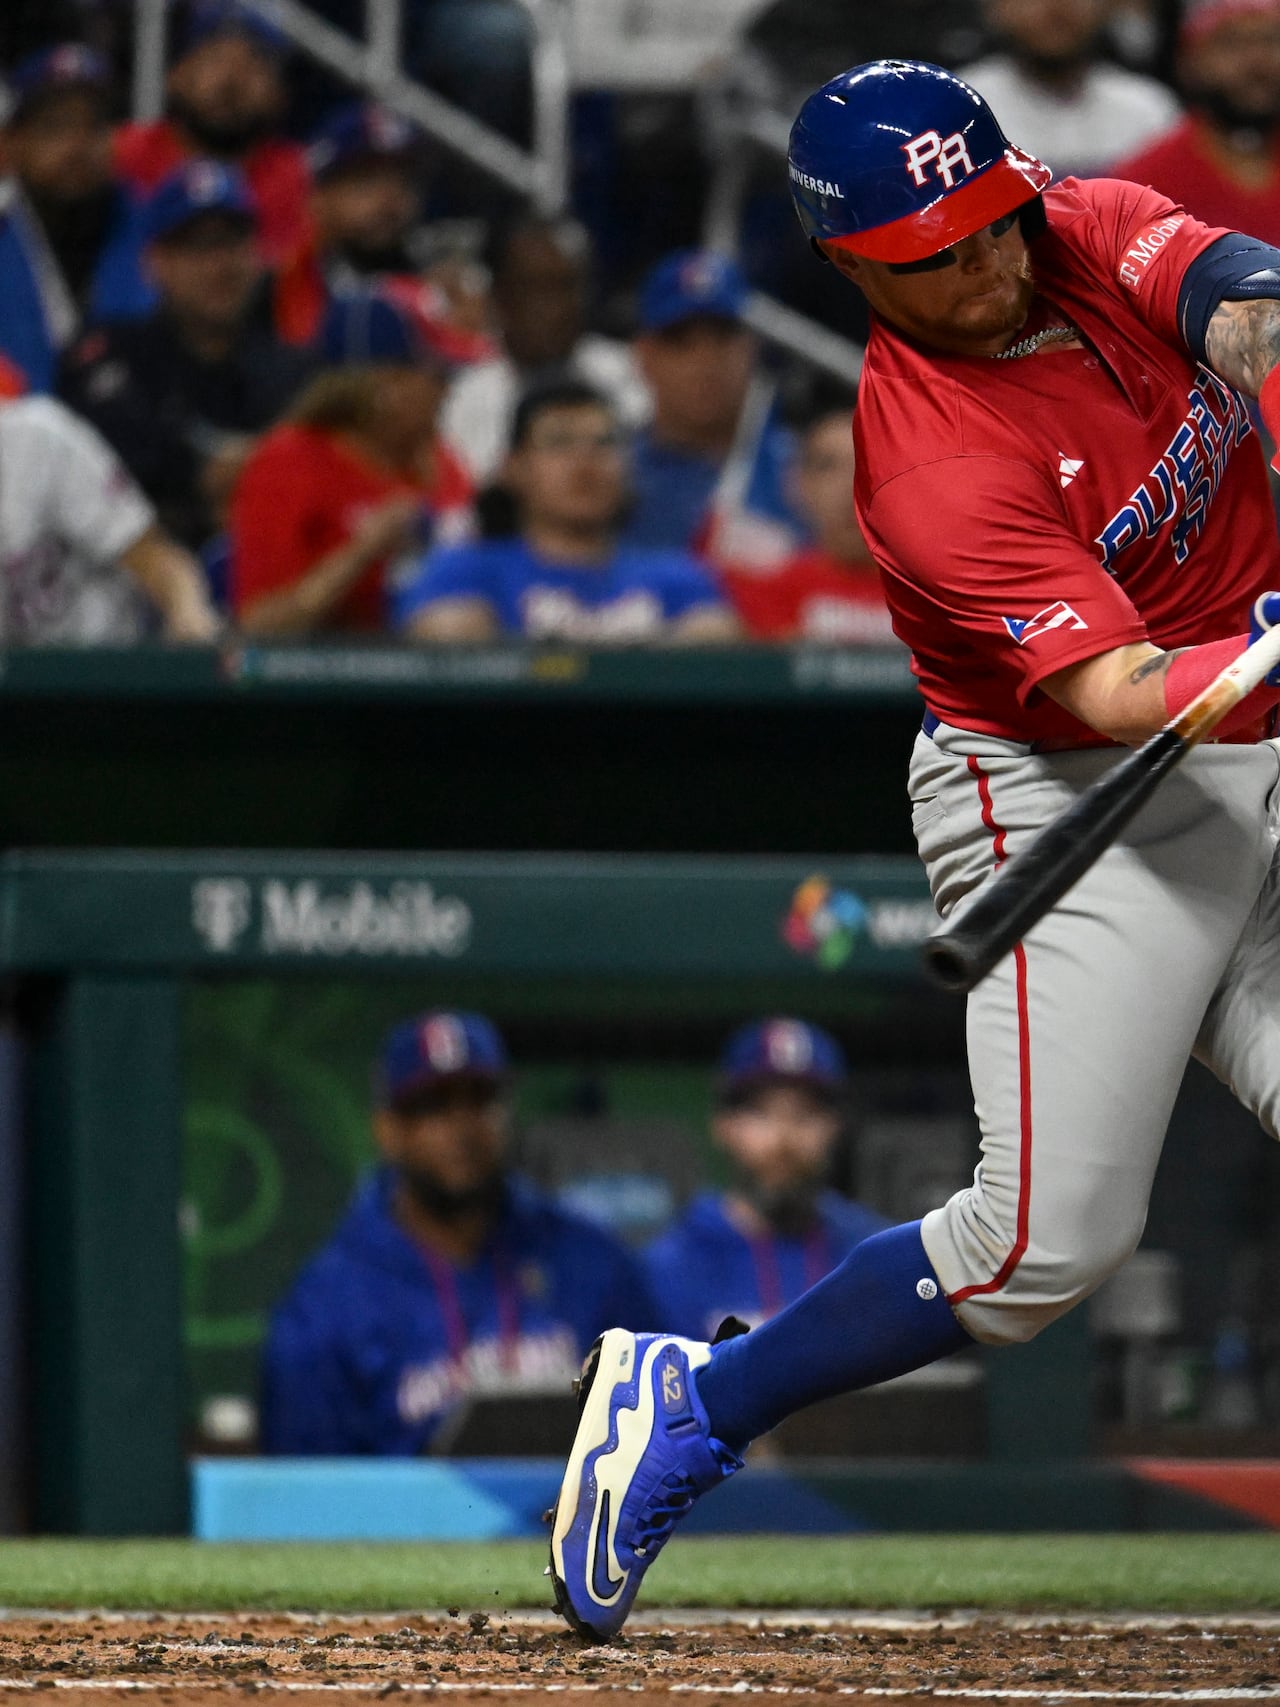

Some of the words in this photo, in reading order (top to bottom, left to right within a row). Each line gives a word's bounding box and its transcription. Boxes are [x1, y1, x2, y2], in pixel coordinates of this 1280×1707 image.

[899, 128, 976, 190] PR
[1126, 218, 1184, 268] Mobil
[261, 877, 472, 958] Mobile
[662, 1363, 681, 1404] 42
